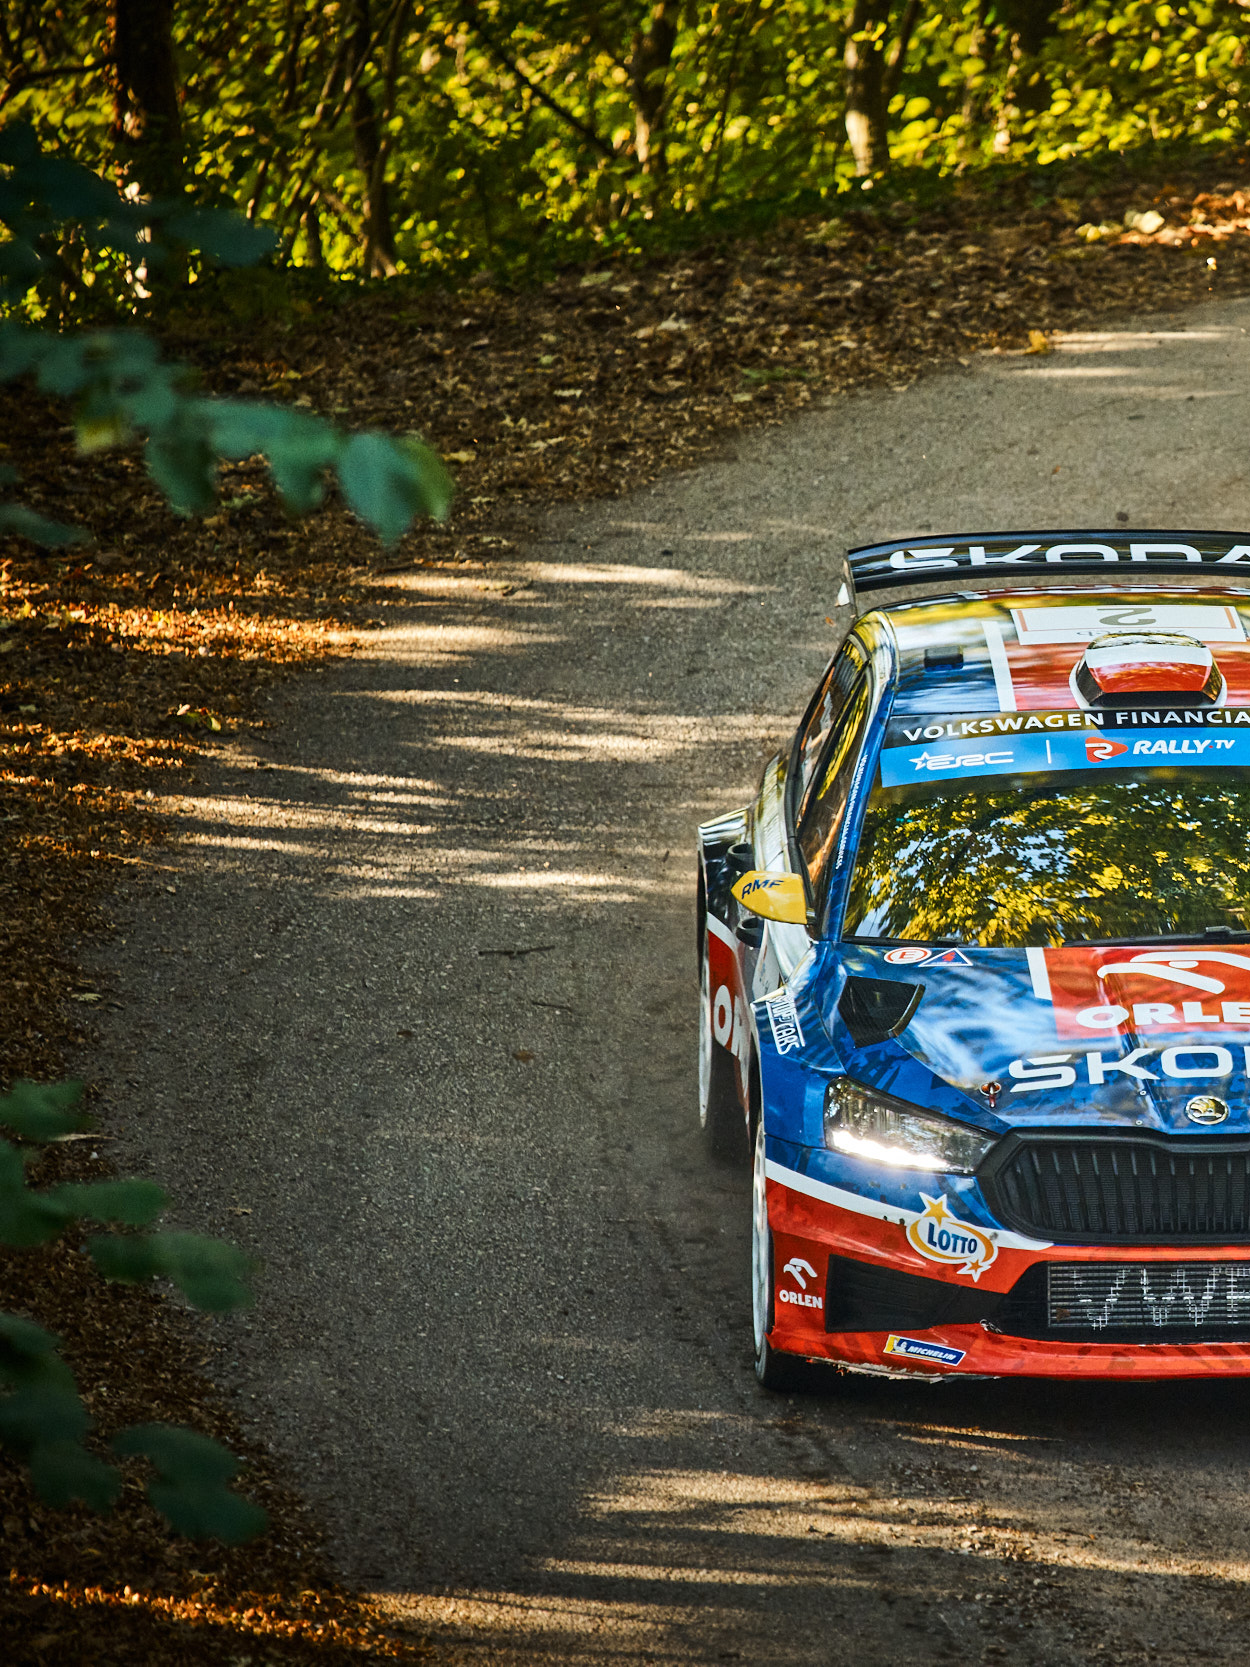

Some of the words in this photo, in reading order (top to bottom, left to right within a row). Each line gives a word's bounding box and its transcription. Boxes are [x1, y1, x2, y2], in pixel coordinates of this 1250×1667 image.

[1096, 607, 1157, 626] 2
[903, 712, 1105, 742] VOLKSWAGEN
[925, 751, 1014, 771] ERC
[741, 879, 785, 900] RMF
[775, 1022, 800, 1055] CARS
[927, 1222, 978, 1254] LOTTO
[779, 1289, 823, 1310] ORLEN
[907, 1345, 957, 1361] MICHELIN
